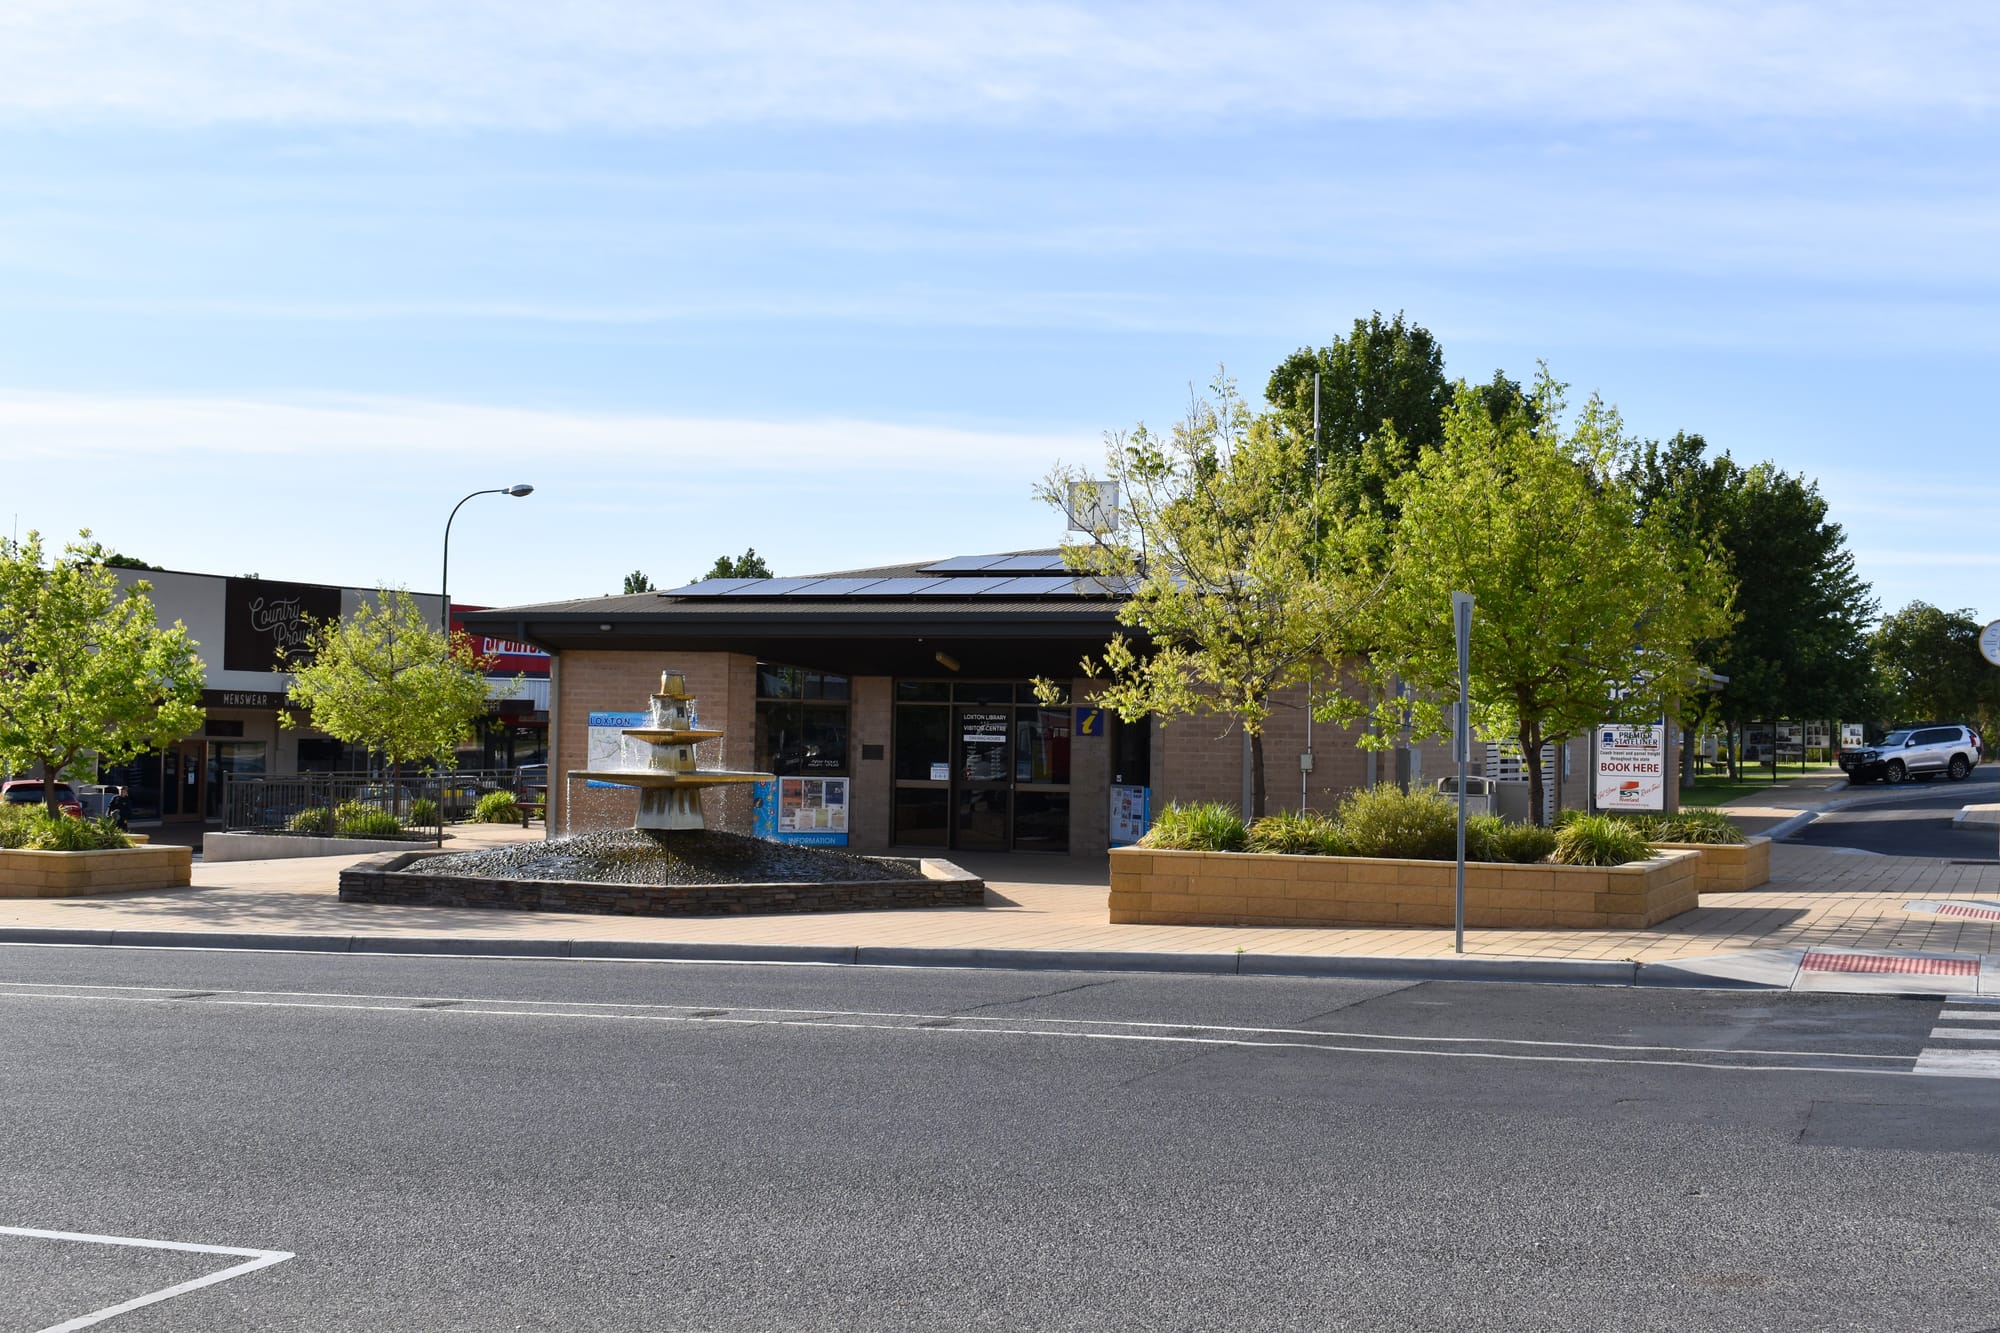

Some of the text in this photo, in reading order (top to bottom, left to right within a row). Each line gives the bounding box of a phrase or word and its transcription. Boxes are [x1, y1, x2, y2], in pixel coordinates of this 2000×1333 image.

[248, 596, 303, 631] Country
[223, 693, 267, 706] MENSWEAR
[590, 717, 632, 727] LOXTON
[963, 713, 985, 721] LOXTON
[1614, 738, 1658, 746] STATELINER
[1600, 762, 1660, 773] BOOK HERE
[788, 837, 837, 845] INFORMATION
